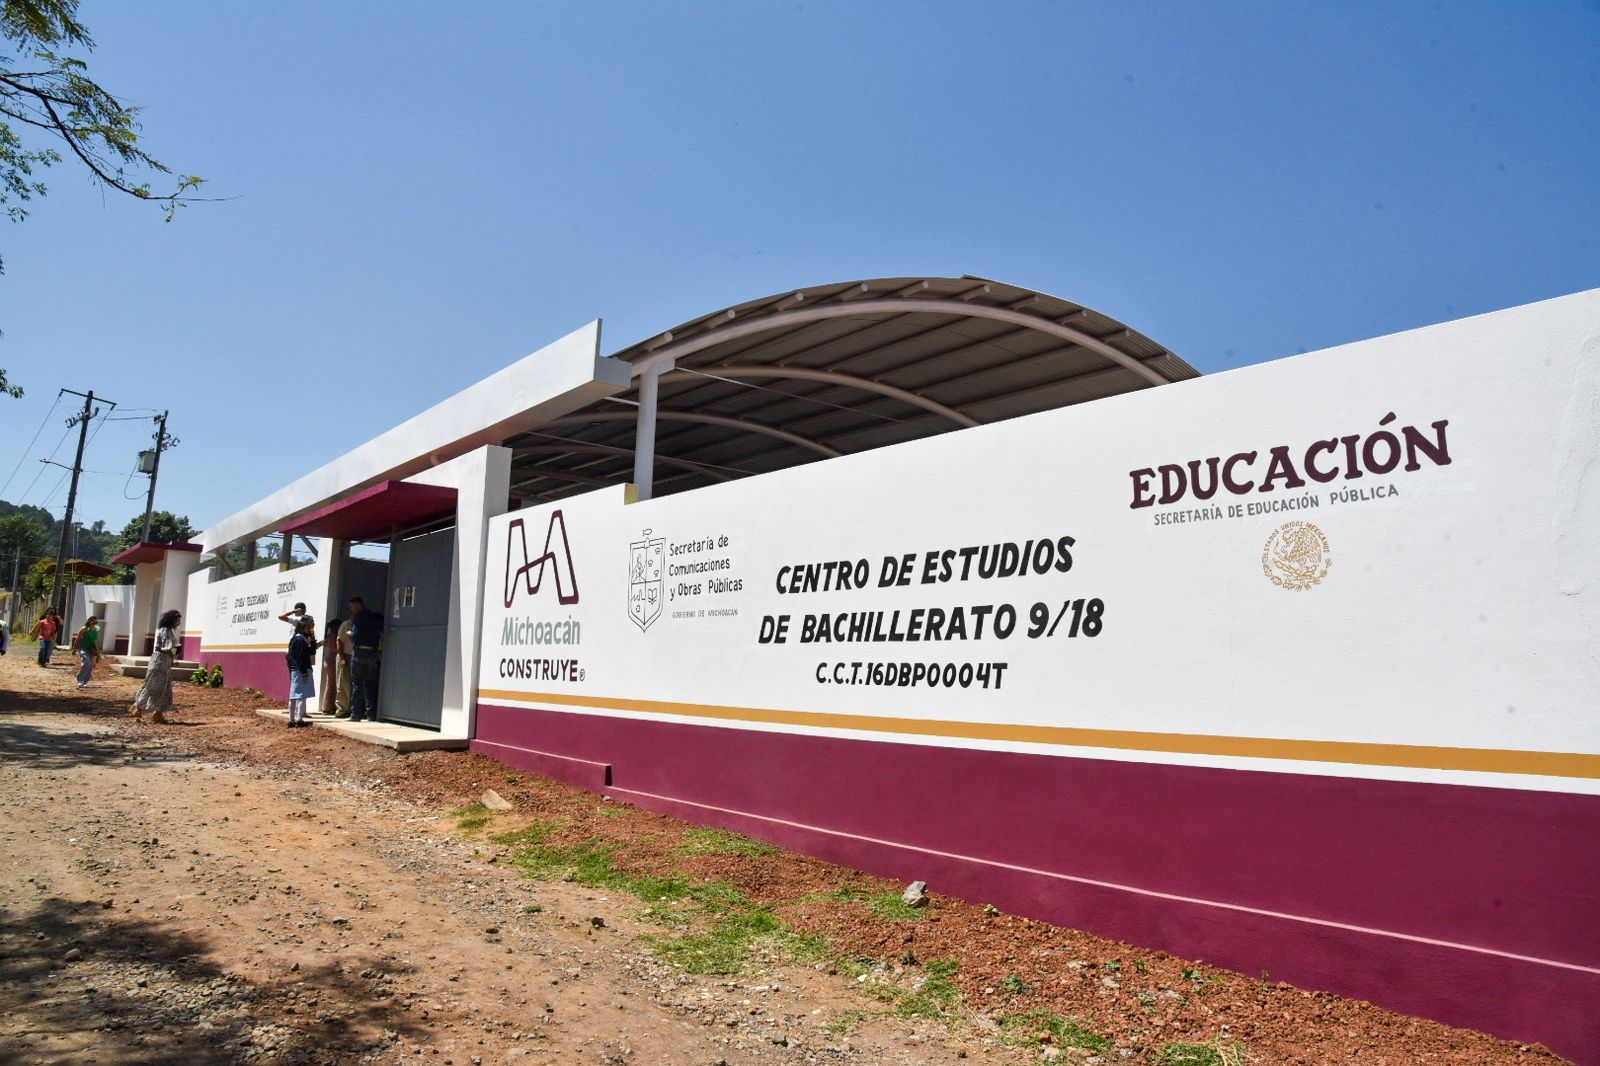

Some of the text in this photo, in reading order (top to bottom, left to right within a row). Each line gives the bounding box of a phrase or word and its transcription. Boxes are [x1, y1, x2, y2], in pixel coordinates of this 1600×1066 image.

[1129, 411, 1452, 509] EDUCACIÓN
[1154, 483, 1399, 526] SECRETARÍA DE EDUCACIÓN PÚBLICA
[717, 533, 729, 548] de
[668, 558, 731, 577] Comunicaciones
[775, 535, 1076, 595] CENTRO DE ESTUDIOS
[670, 577, 743, 602] y Obras Públicas
[697, 608, 705, 618] DE
[758, 597, 1105, 644] DE BACHILLERATO 9/18
[501, 615, 581, 646] Michoacán
